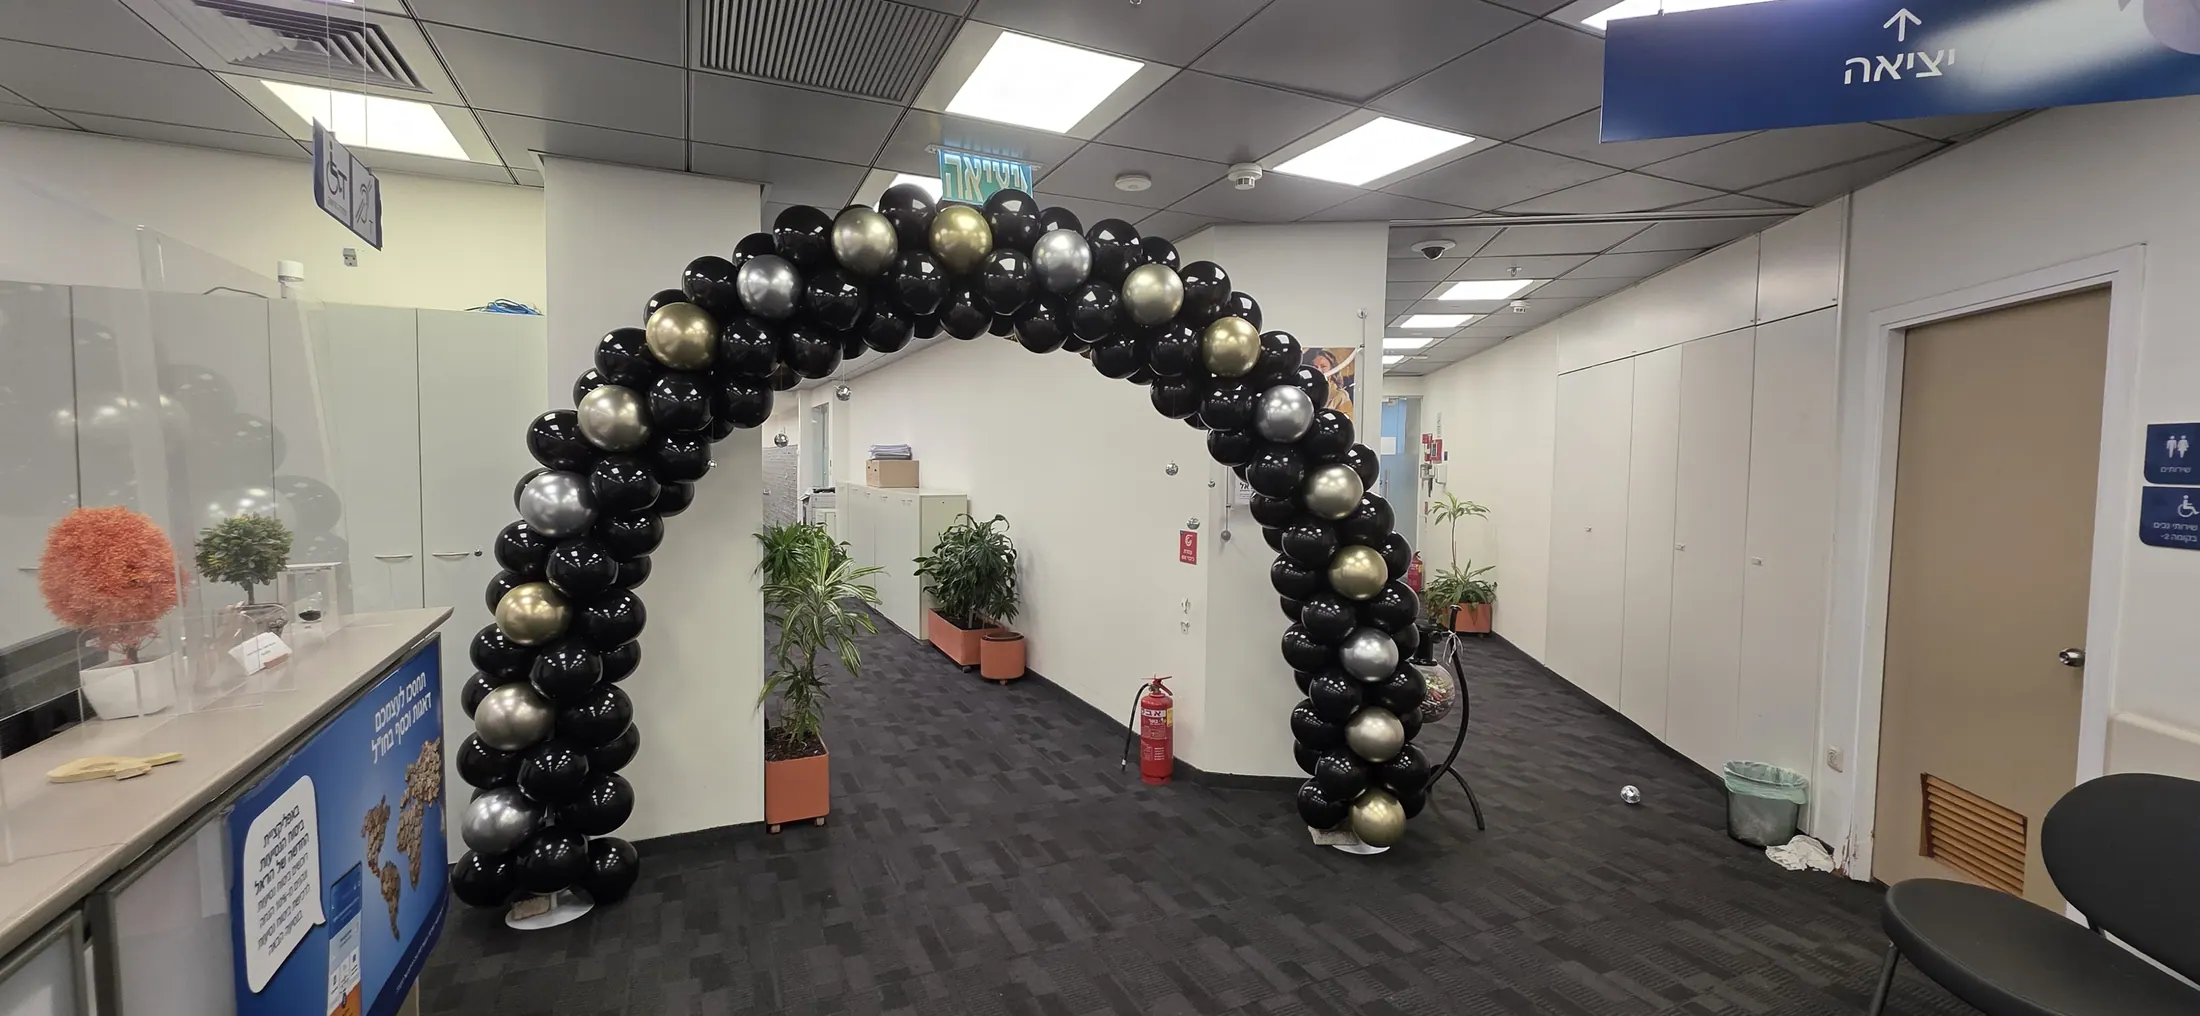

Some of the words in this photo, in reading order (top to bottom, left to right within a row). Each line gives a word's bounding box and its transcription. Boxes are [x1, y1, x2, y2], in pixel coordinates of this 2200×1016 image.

[1844, 48, 1956, 84] יציאה
[2170, 534, 2198, 543] בקומה
[2172, 523, 2199, 531] שירותי
[375, 685, 405, 732] לעצמכם
[412, 692, 432, 723] דאגות
[395, 710, 411, 745] וכסף
[288, 819, 304, 842] ביטוח
[259, 837, 287, 872] הנסיעות
[288, 832, 310, 860] החדשה
[276, 856, 287, 873] של
[254, 867, 274, 896] הראל
